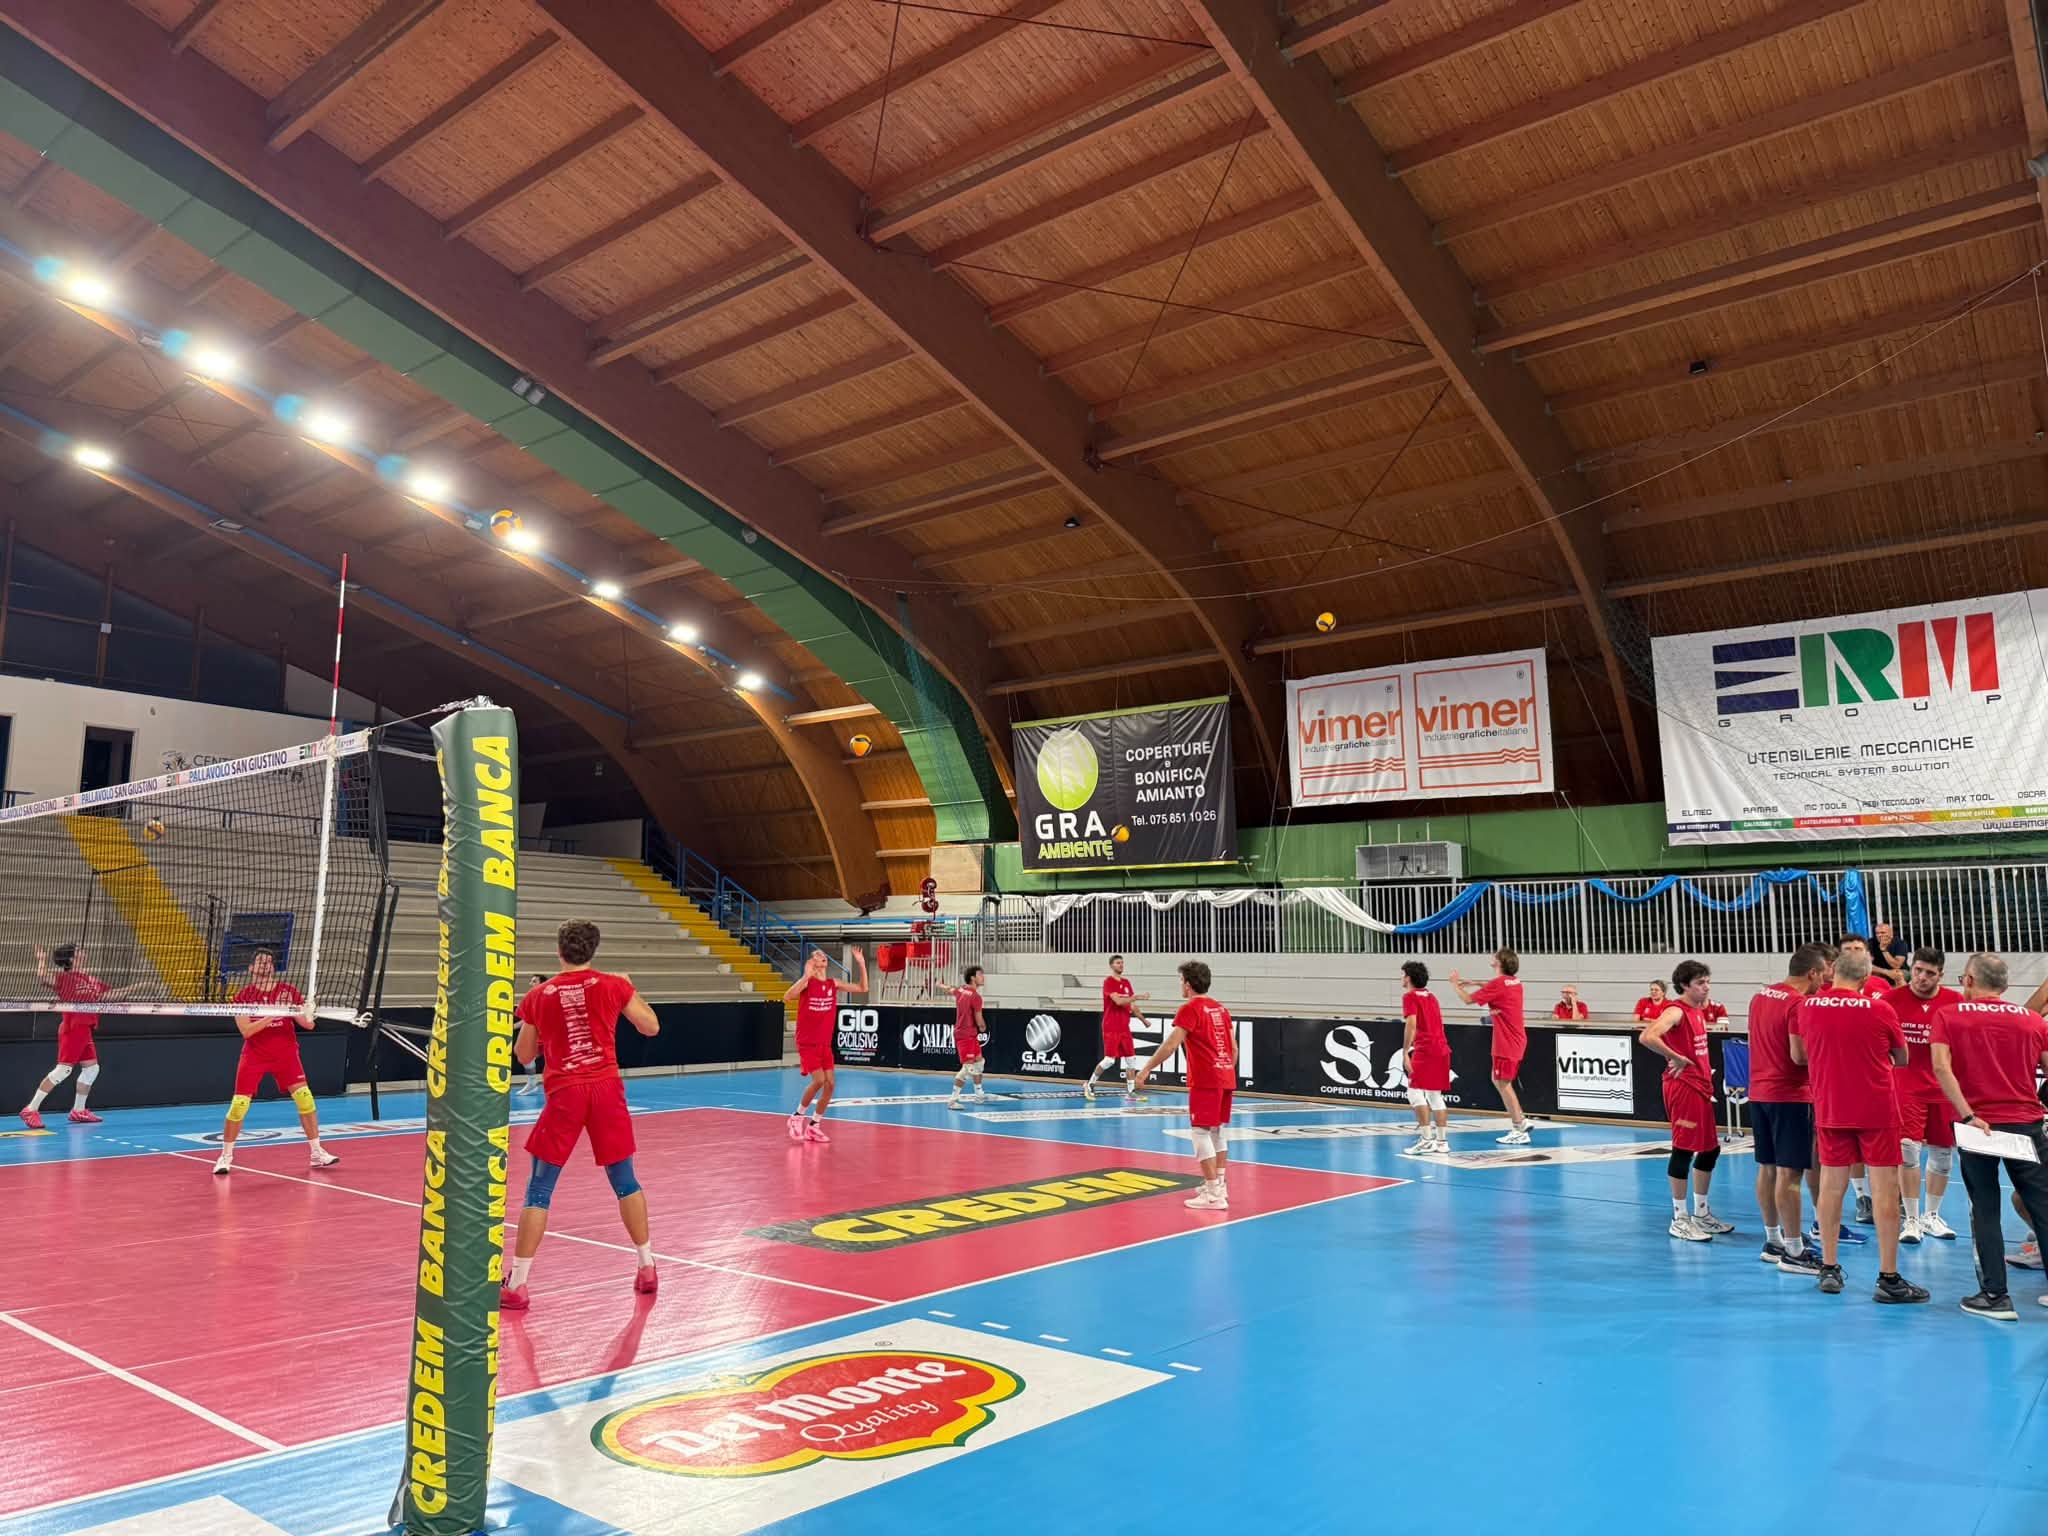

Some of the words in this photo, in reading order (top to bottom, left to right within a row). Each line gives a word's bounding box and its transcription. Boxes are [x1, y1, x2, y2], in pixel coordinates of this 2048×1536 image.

[1417, 695, 1535, 733] vimer
[1300, 708, 1401, 745] vimer
[1423, 726, 1529, 743] industriegraficheitaliane
[1125, 740, 1212, 763] COPERTURE
[1746, 745, 1852, 765] UTENSILERIE
[1860, 735, 1976, 758] MECCANICHE
[188, 763, 230, 784] PALLAVOLO
[231, 759, 248, 775] SAN
[248, 750, 288, 771] GIUSTINO
[1164, 759, 1171, 768] e
[1772, 768, 1834, 782] TECHNICAL
[1837, 765, 1886, 777] SYSTEM
[1891, 760, 1951, 774] SOLUTION
[1134, 766, 1207, 786] BONIFICA
[81, 788, 114, 804] PALLAVOLO
[114, 785, 127, 798] SAN
[127, 778, 158, 796] GIUSTINO
[1135, 784, 1207, 803] AMIANTO
[1945, 794, 1967, 803] MAX
[1969, 793, 1996, 801] TOOL
[472, 736, 515, 891] BANCA
[1681, 808, 1713, 817] ELMEC
[1742, 805, 1778, 814] RAMAS
[1803, 803, 1817, 811] MC
[1820, 802, 1848, 810] TOOLS
[1131, 814, 1149, 826] Tel.
[1149, 813, 1168, 825] 075
[1169, 812, 1187, 824] 851
[1037, 839, 1115, 860] AMBIENTE
[485, 911, 516, 1095] CREDEM
[1804, 997, 1872, 1009] macron
[1958, 1001, 2031, 1016] macron
[838, 1008, 879, 1032] GIO
[1021, 1050, 1066, 1064] G.R.A.
[1558, 1051, 1630, 1076] vimer
[1320, 1085, 1373, 1097] COPERTURE
[419, 1130, 446, 1297] BANCA
[811, 1170, 1181, 1243] CREDEM
[410, 1317, 447, 1516] CREDEM
[640, 1412, 787, 1458] Del
[755, 1361, 968, 1423] Monte
[799, 1399, 939, 1446] Quality
